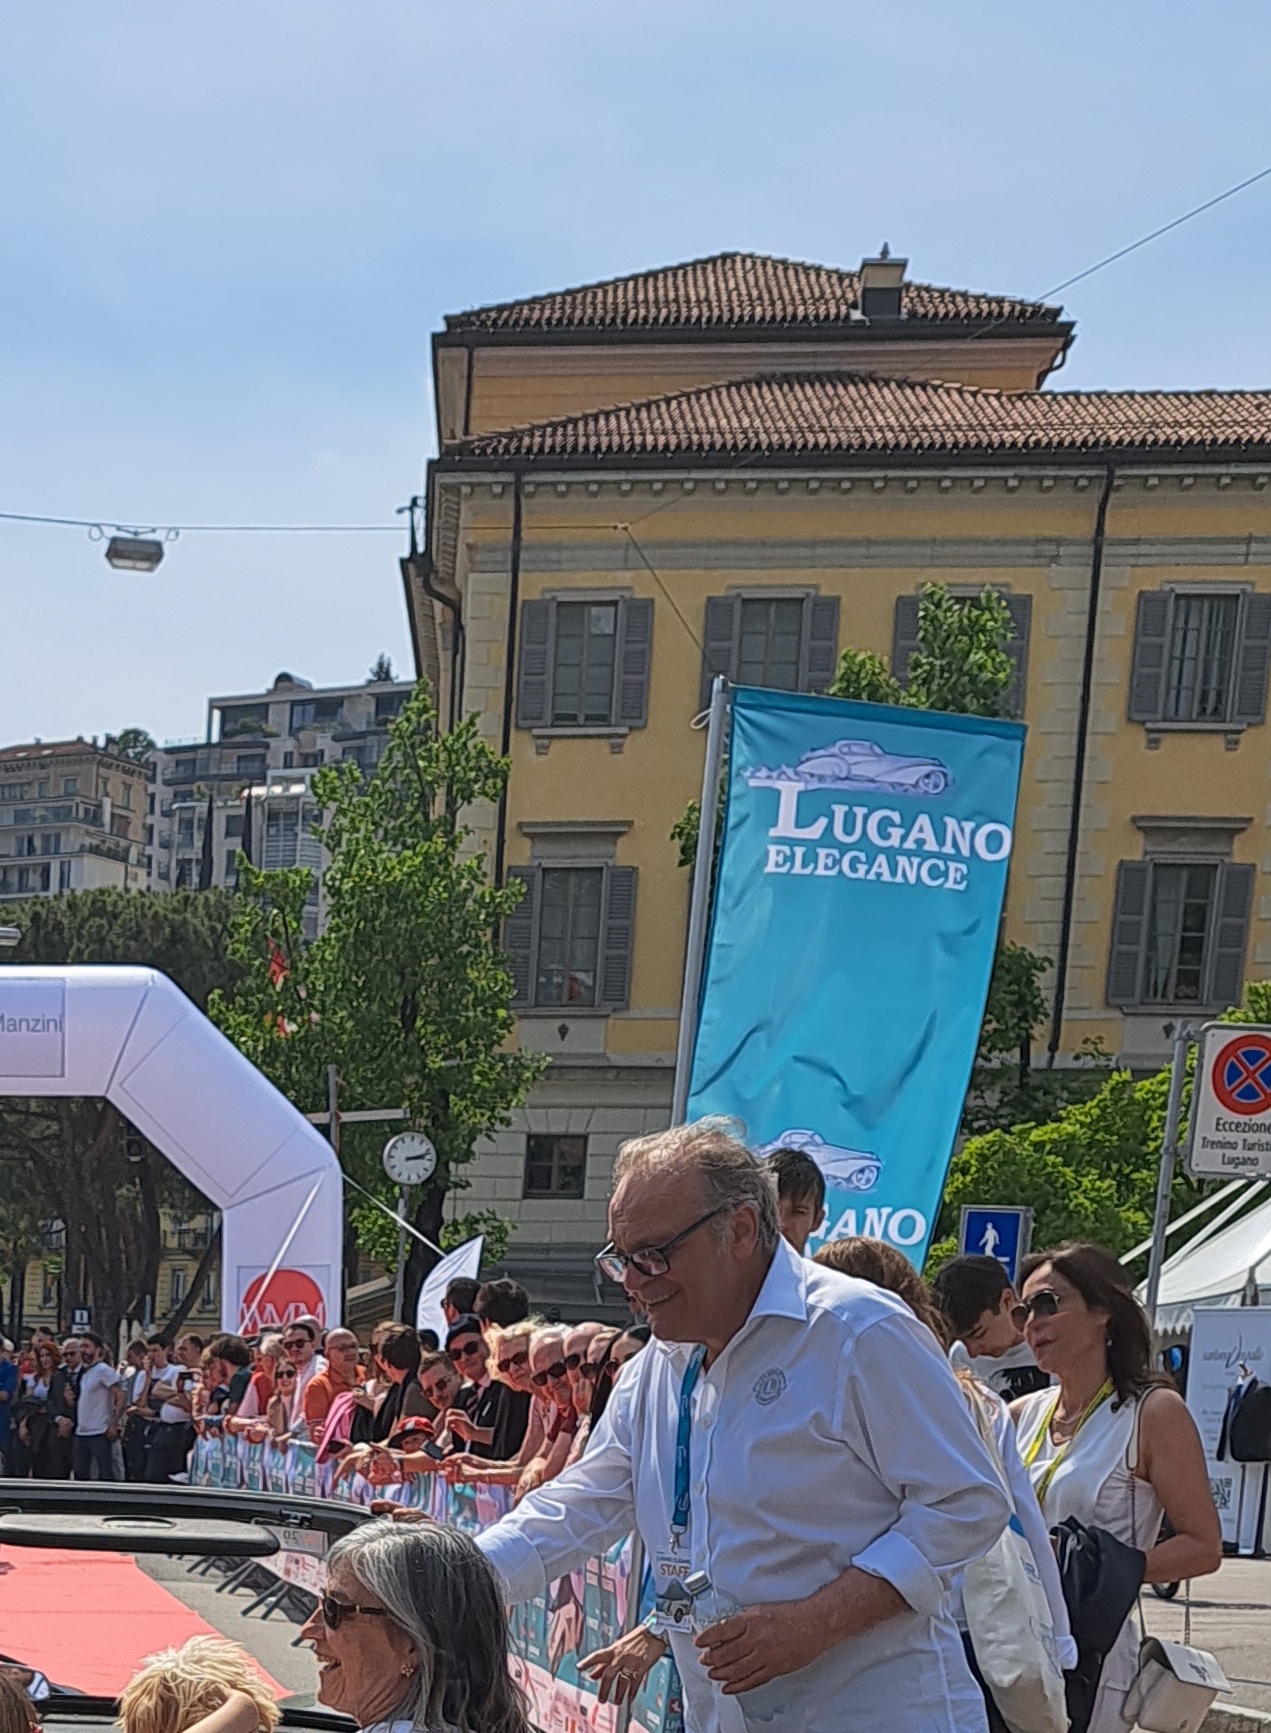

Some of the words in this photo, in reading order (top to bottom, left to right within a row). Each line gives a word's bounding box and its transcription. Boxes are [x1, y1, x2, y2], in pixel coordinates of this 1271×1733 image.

[748, 779, 1012, 862] LUGANO
[764, 844, 968, 892] ELEGANCE
[1221, 1153, 1260, 1169] Lugano
[660, 1563, 690, 1579] STAFF
